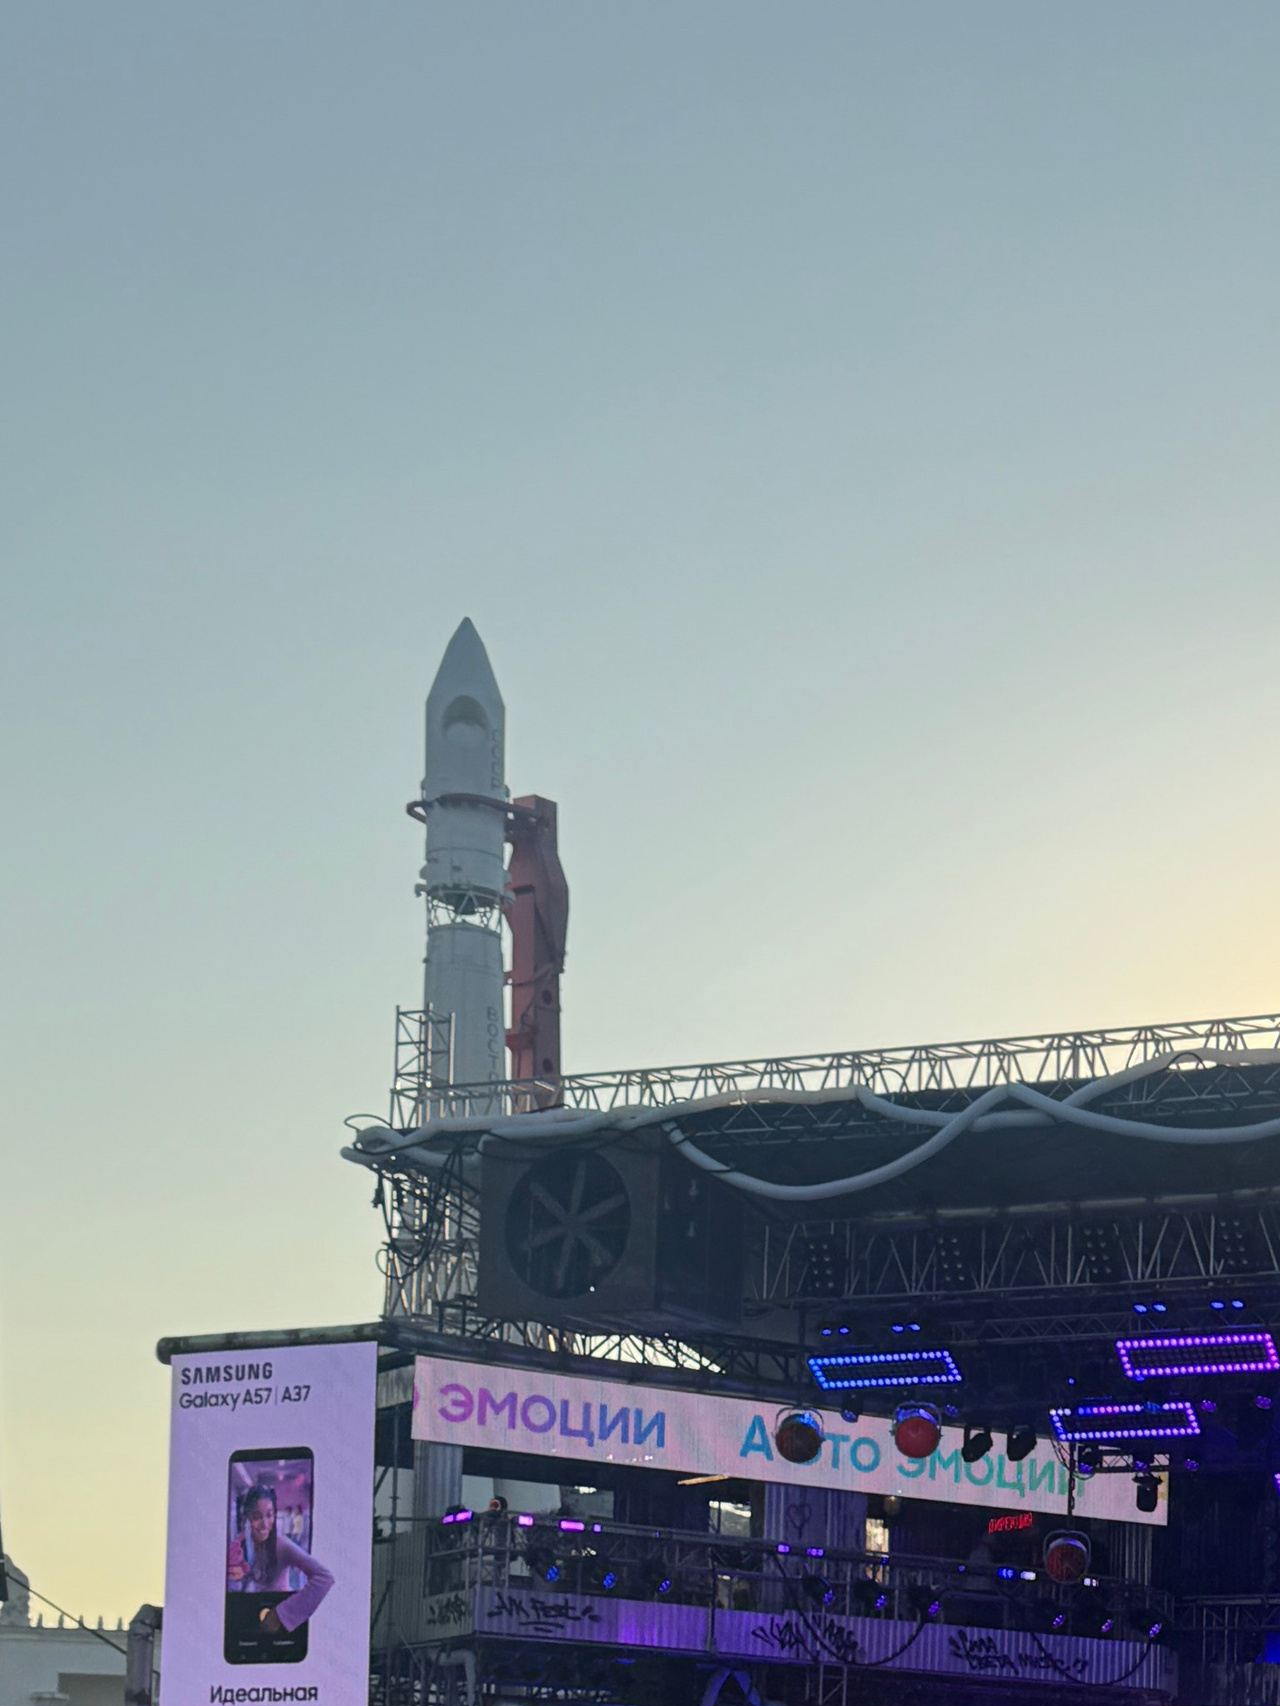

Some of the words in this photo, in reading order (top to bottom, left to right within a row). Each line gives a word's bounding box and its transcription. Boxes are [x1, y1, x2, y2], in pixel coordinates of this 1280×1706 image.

[181, 1362, 273, 1386] SAMSUNG
[179, 1390, 241, 1412] Galaxy
[242, 1387, 273, 1406] A57
[281, 1384, 311, 1403] A37
[438, 1383, 666, 1448] ЭМОЦИИ
[739, 1414, 774, 1462] А
[210, 1685, 318, 1706] Идеальная
